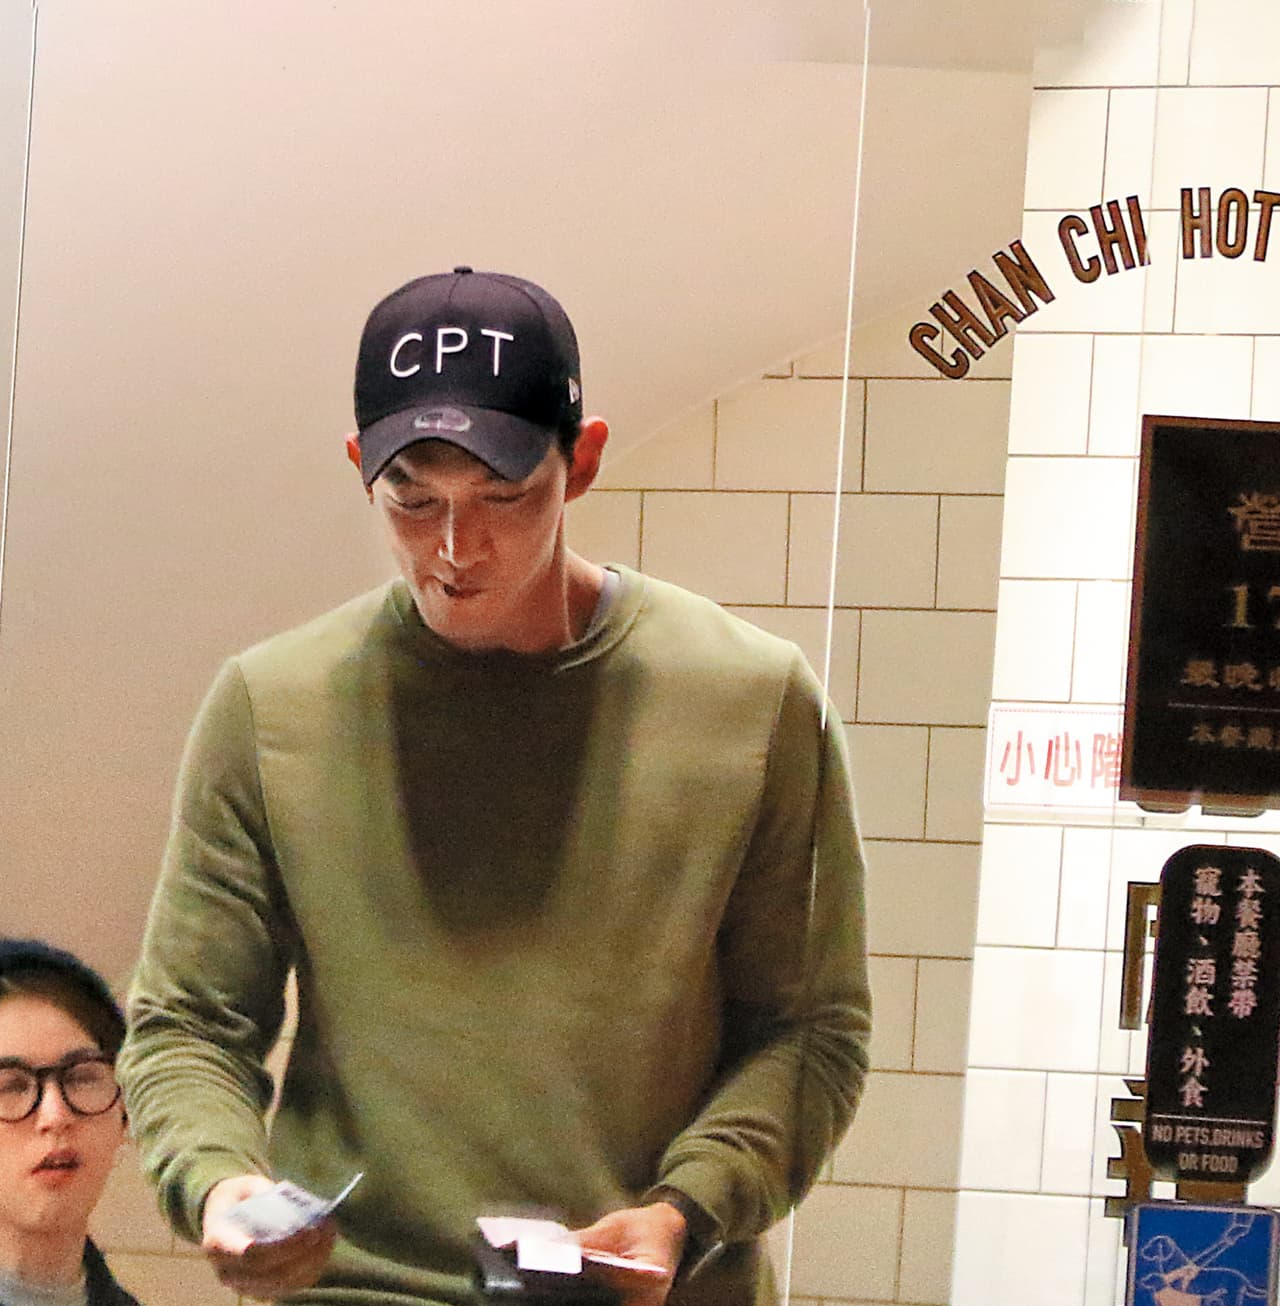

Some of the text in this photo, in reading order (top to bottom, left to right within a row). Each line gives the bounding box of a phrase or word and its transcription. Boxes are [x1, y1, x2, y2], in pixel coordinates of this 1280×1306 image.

[909, 239, 1056, 380] CHAN
[1057, 195, 1151, 284] CHI
[389, 327, 514, 378] CPT
[1152, 1125, 1173, 1142] NO
[1179, 1153, 1238, 1173] OR FOOD
